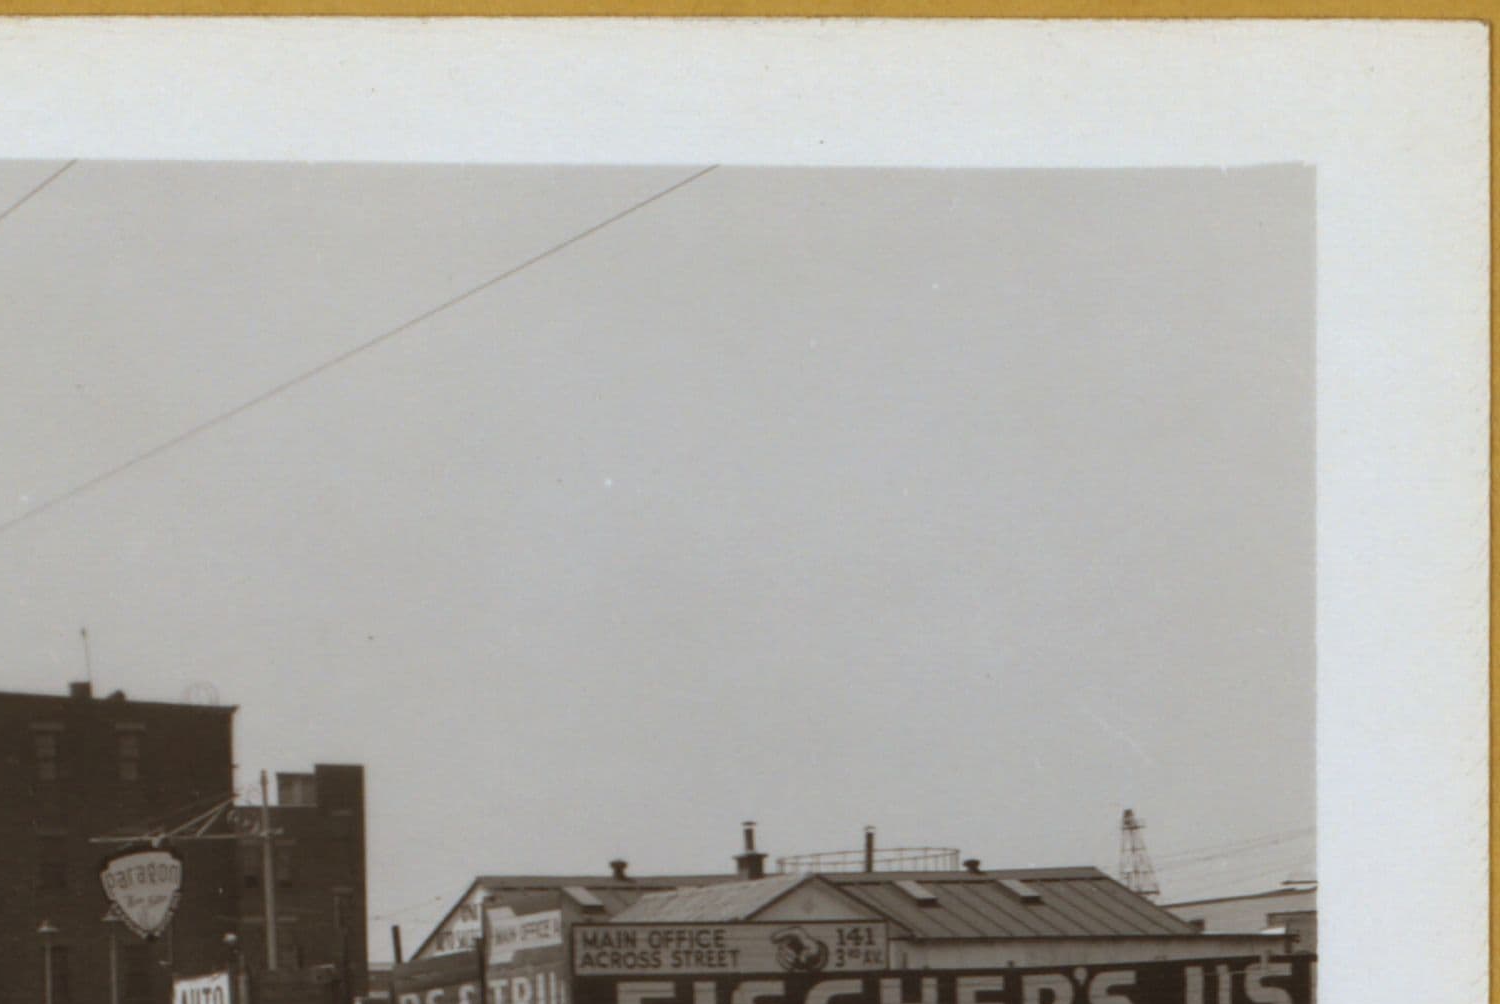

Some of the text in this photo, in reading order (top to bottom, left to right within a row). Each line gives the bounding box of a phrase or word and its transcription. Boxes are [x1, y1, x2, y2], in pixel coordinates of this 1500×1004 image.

[581, 929, 726, 950] MAIN OFFICE
[836, 927, 876, 946] 141
[580, 949, 741, 969] ACROSS STREET
